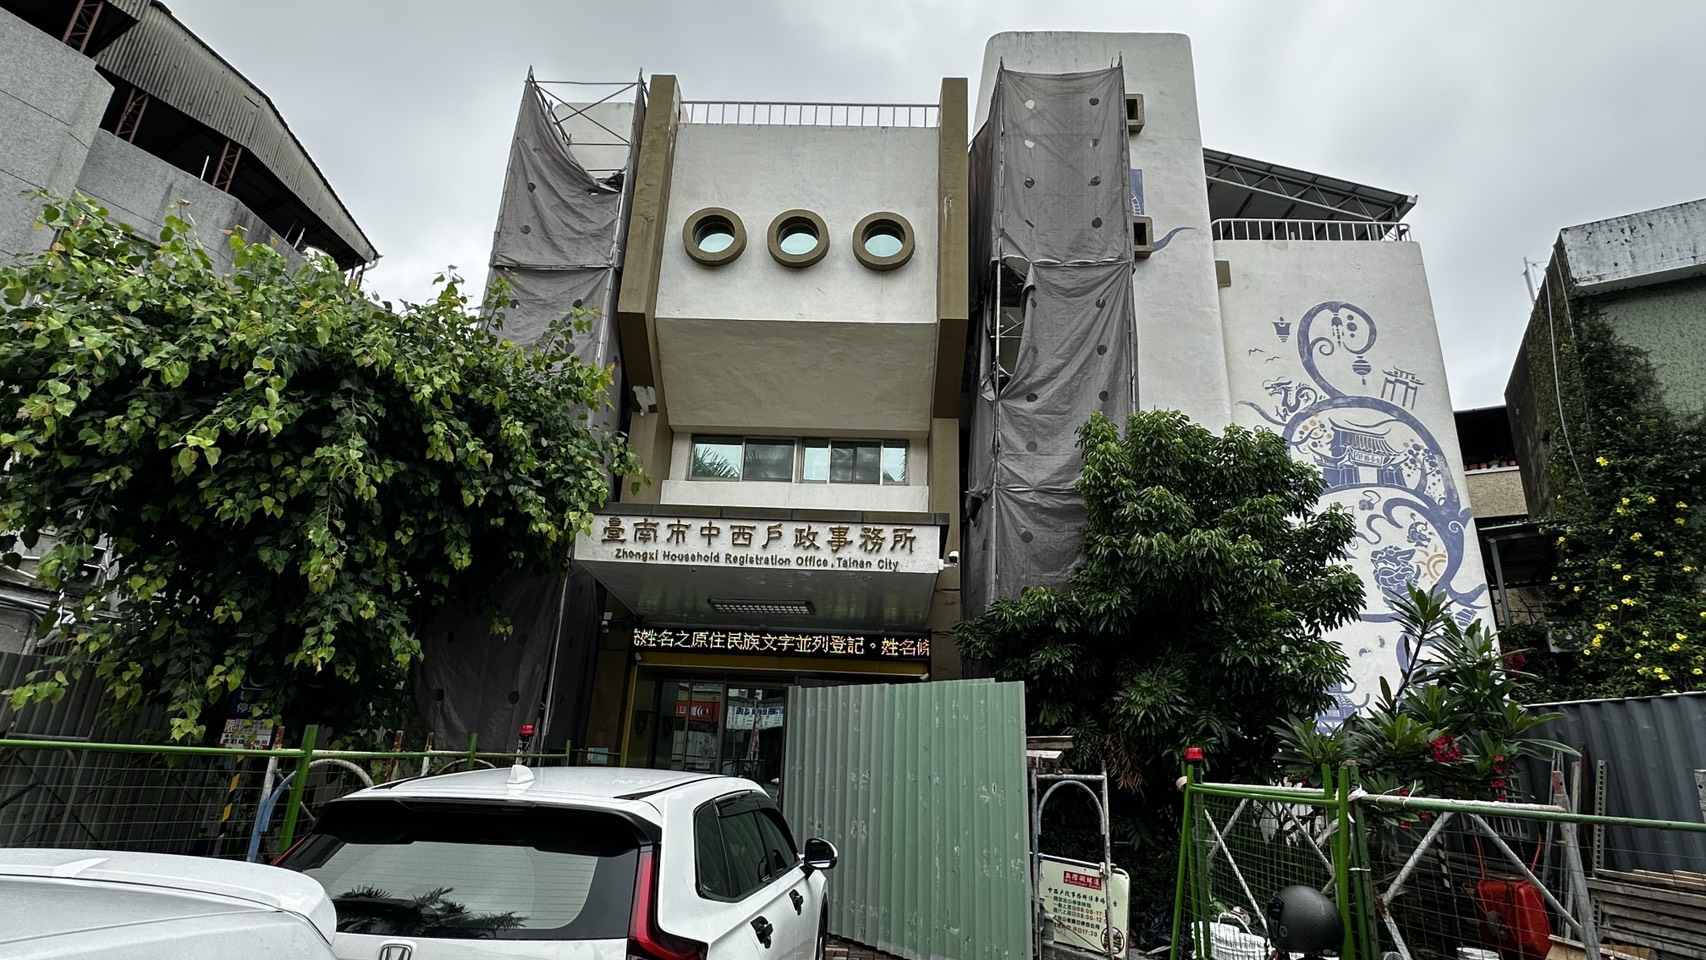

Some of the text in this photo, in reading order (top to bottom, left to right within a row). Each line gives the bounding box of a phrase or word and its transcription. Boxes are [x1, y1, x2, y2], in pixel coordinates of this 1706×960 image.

[601, 515, 917, 554] 臺南市中西戶政事務所
[614, 548, 659, 562] Zhongxi
[662, 549, 720, 563] Household
[725, 552, 792, 566] Registration
[836, 556, 873, 569] Tainan
[877, 557, 899, 572] City
